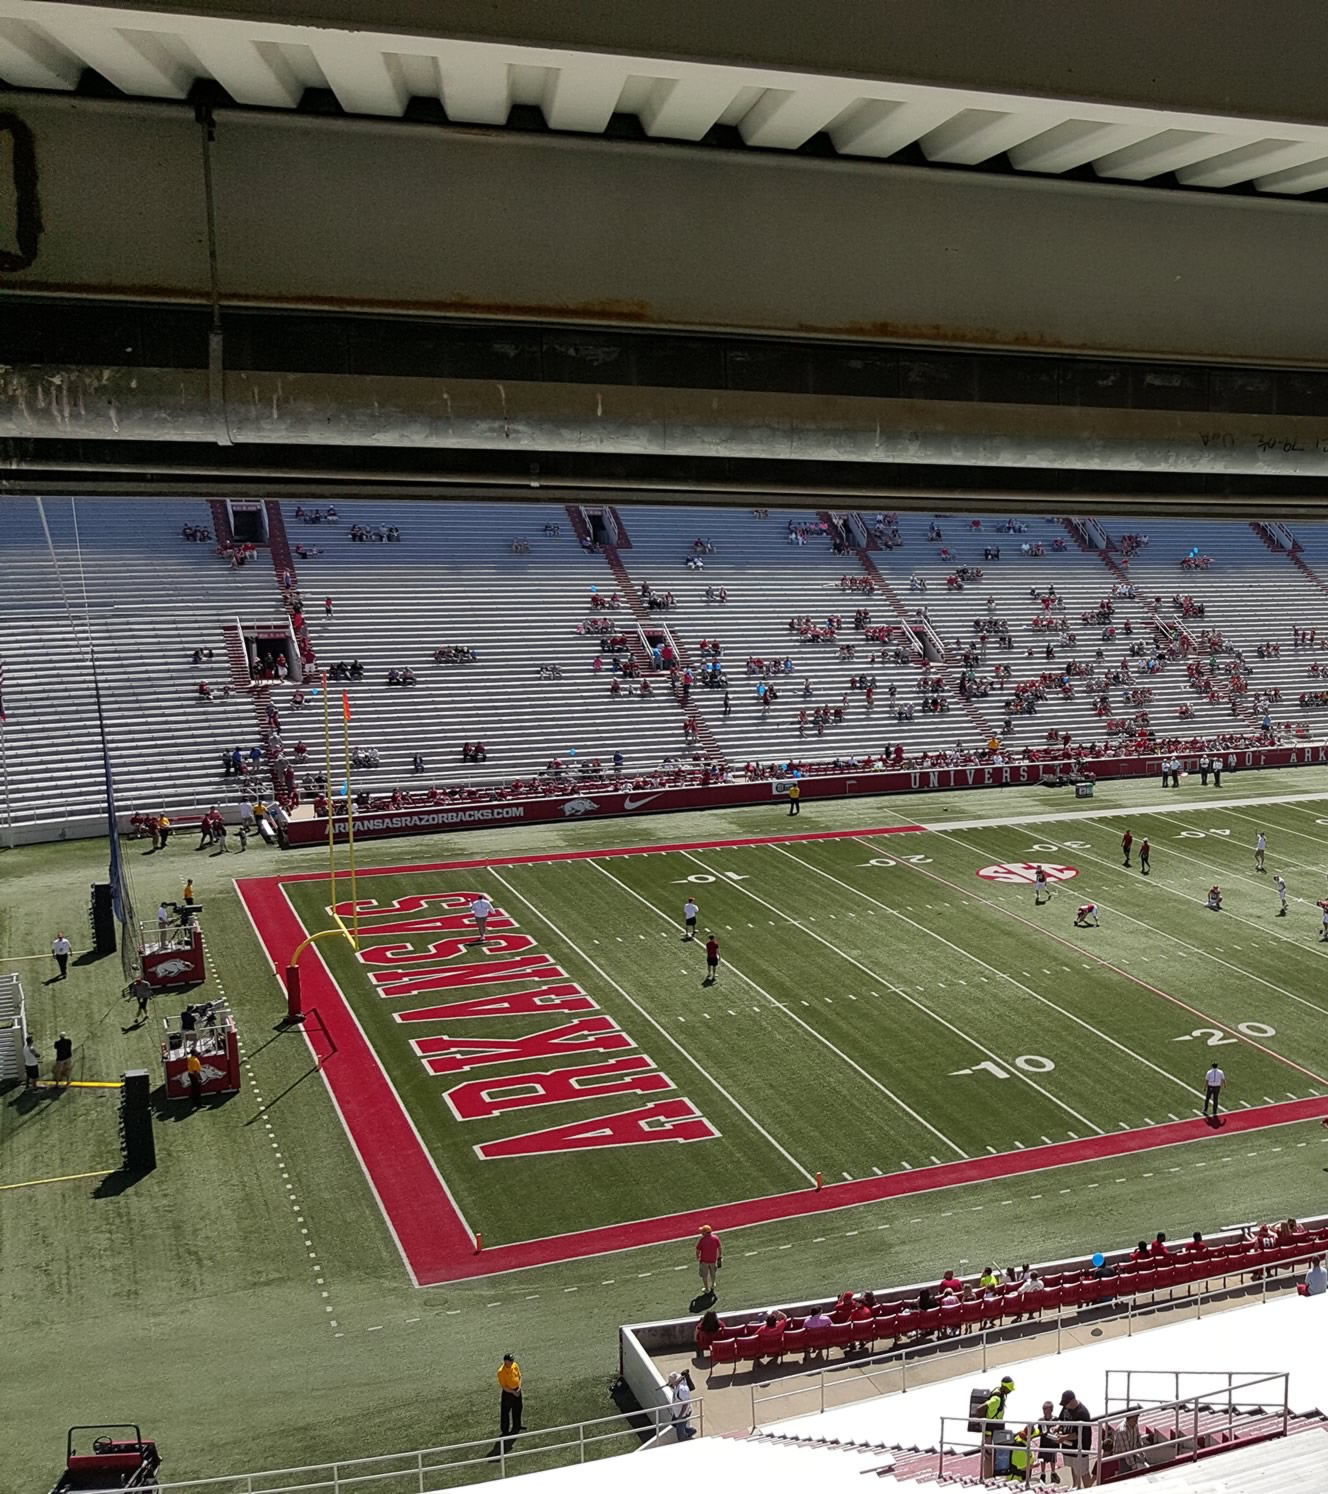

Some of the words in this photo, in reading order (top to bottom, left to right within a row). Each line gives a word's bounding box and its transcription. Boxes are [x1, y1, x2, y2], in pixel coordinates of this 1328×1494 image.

[325, 807, 524, 835] ARKANSASRAZORBACKS.COM
[1180, 828, 1231, 838] 40
[1032, 840, 1092, 852] 30
[869, 854, 933, 868] 20
[687, 871, 750, 883] 10
[978, 862, 1077, 883] SEC
[325, 891, 722, 1160] ARKANSAS
[1191, 1021, 1276, 1046] 20
[971, 1055, 1055, 1079] 10
